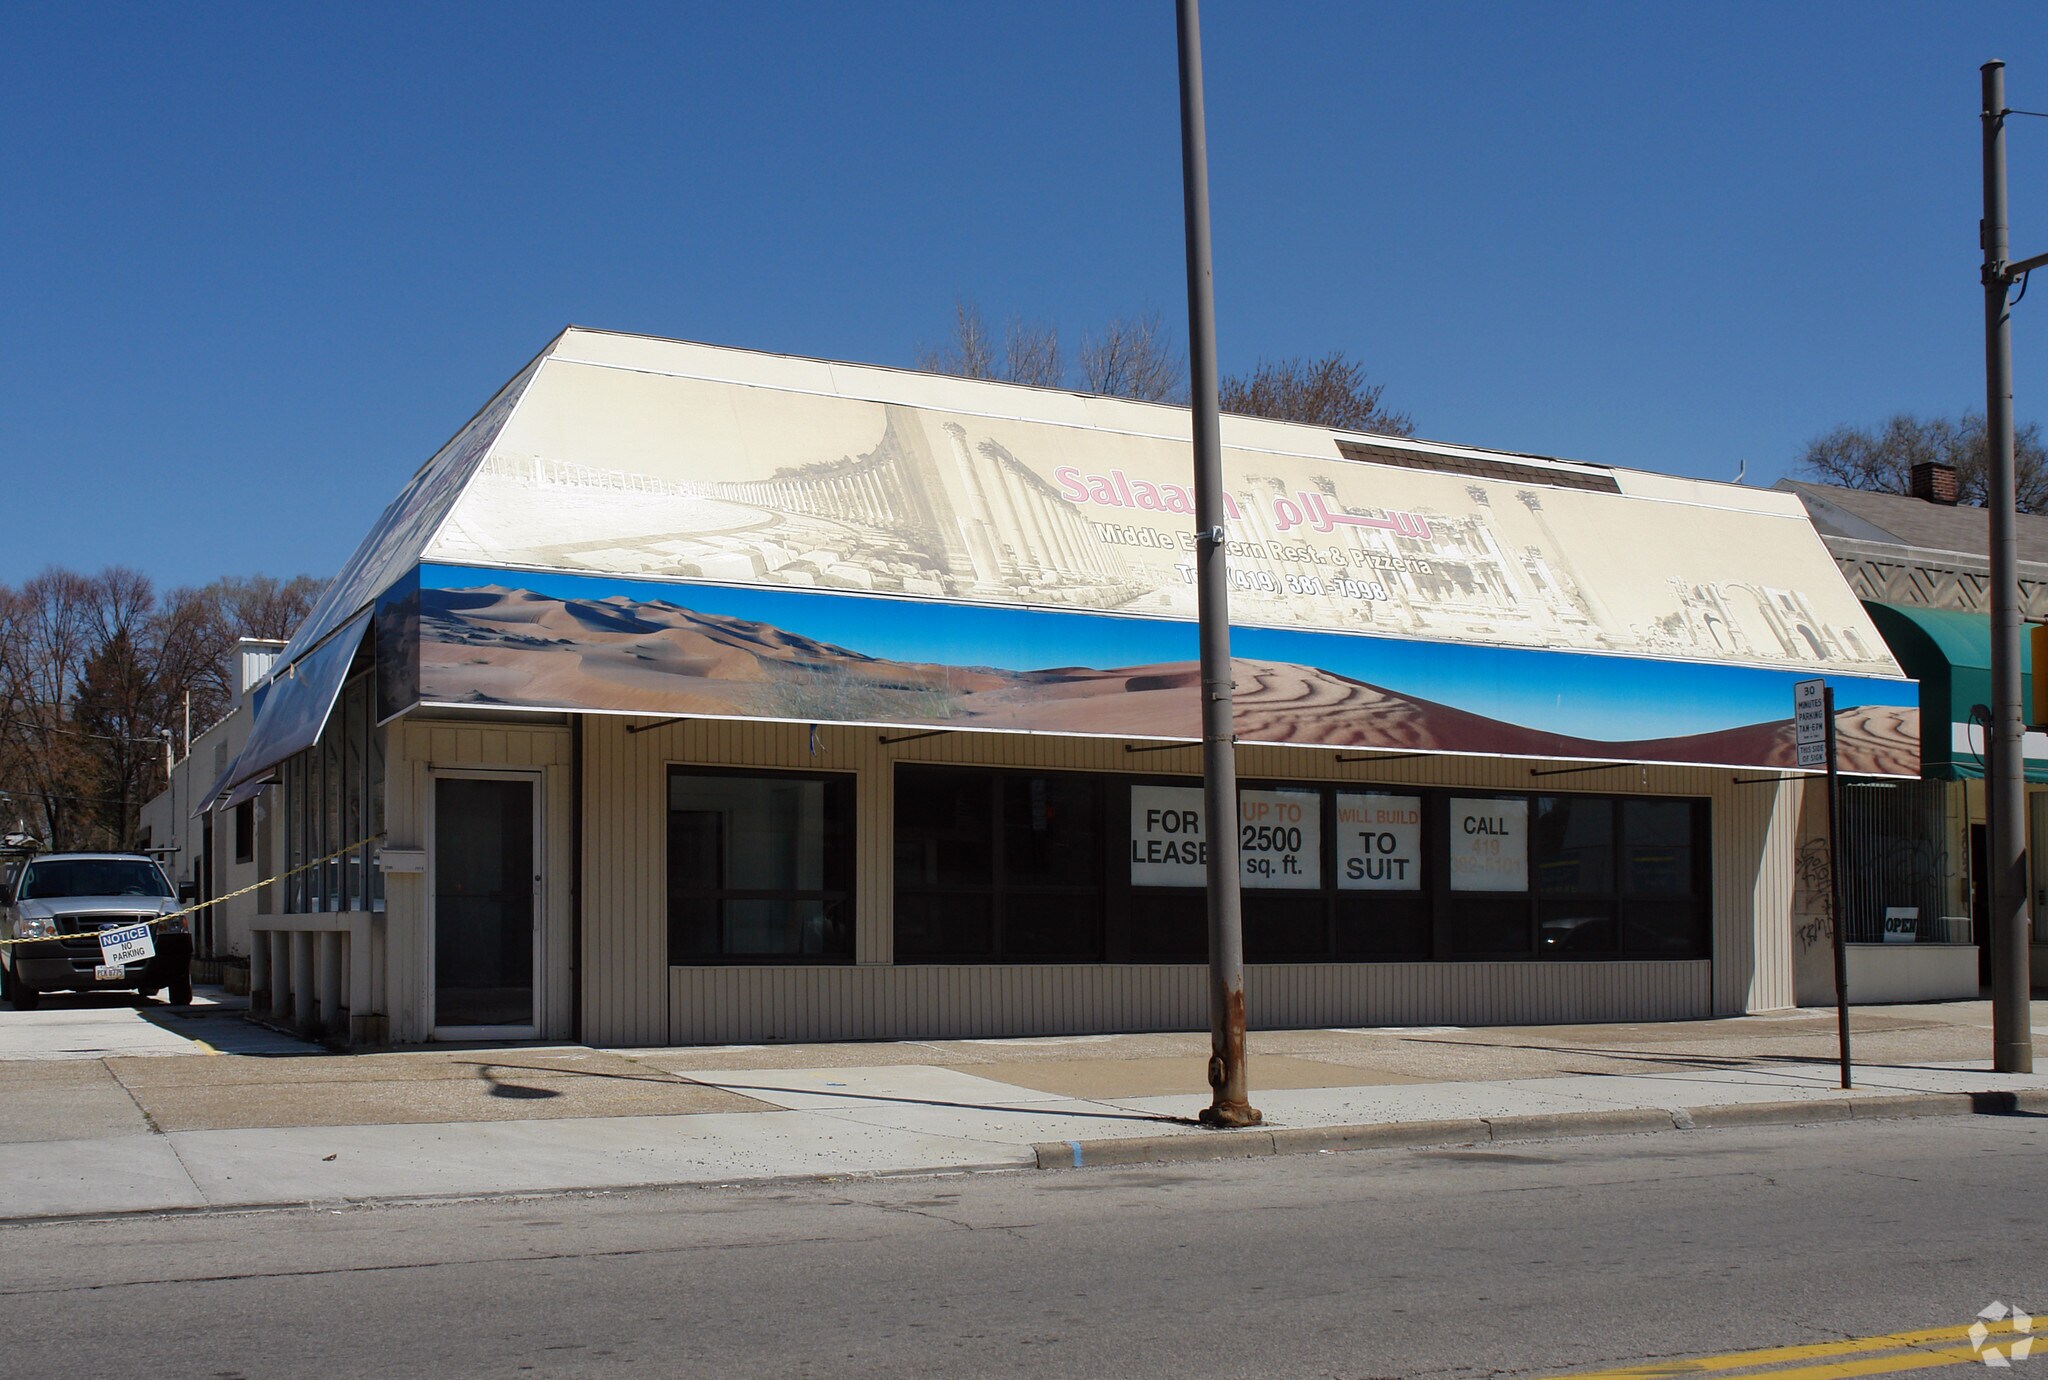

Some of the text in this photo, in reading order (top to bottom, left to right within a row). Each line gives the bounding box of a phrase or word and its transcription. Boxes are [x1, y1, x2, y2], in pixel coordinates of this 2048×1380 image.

[1094, 523, 1433, 576] Middle Eern Rest. & Pizzeria
[1226, 566, 1282, 594] (419)
[1286, 574, 1388, 602] 381-7998
[1804, 686, 1815, 696] 30
[1798, 698, 1822, 710] MINUTES
[1799, 710, 1822, 722] PARKING
[1800, 744, 1824, 754] THIS SIDE
[1802, 753, 1823, 763] OF SIGN
[1242, 801, 1302, 823] UP TO
[1338, 809, 1419, 824] WILL BUILD
[1146, 809, 1199, 834] FOR
[1464, 816, 1509, 835] CALL
[1242, 825, 1302, 852] 2500
[1358, 832, 1397, 854] TO
[1471, 838, 1500, 856] 419
[1246, 854, 1303, 879] sq. ft.
[1346, 857, 1410, 880] SUIT
[1886, 918, 1917, 933] OPEN
[102, 928, 146, 946] NOTICE
[112, 947, 145, 961] PARKING
[121, 942, 132, 951] NO
